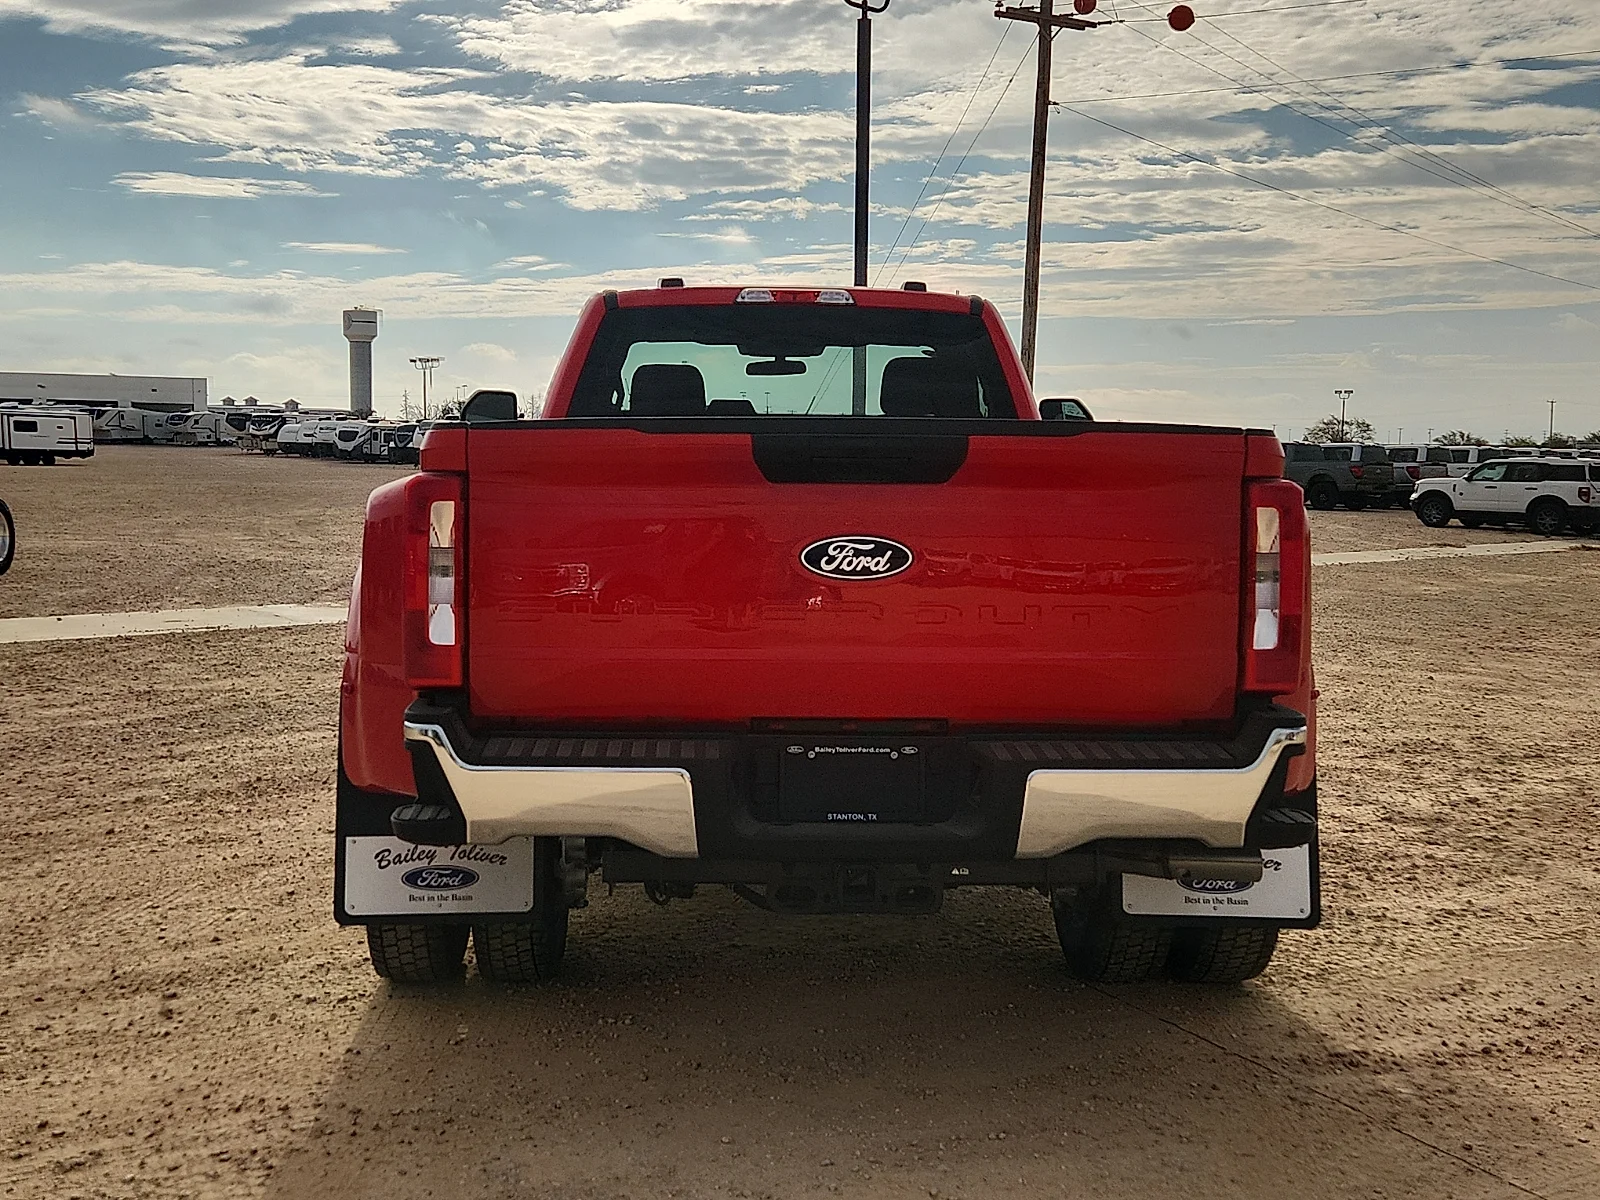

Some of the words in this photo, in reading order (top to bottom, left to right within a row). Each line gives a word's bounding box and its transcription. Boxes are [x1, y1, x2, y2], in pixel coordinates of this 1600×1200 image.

[820, 541, 893, 571] Ford
[827, 813, 867, 821] STANTON,
[868, 813, 877, 821] TX
[374, 843, 438, 869] Bailey
[416, 869, 463, 887] Ford
[408, 894, 426, 902] Best
[428, 894, 436, 902] in
[437, 893, 450, 902] the
[1184, 895, 1201, 904] Best
[1202, 896, 1211, 905] in
[1212, 897, 1225, 905] the
[1226, 896, 1249, 906] Basin
